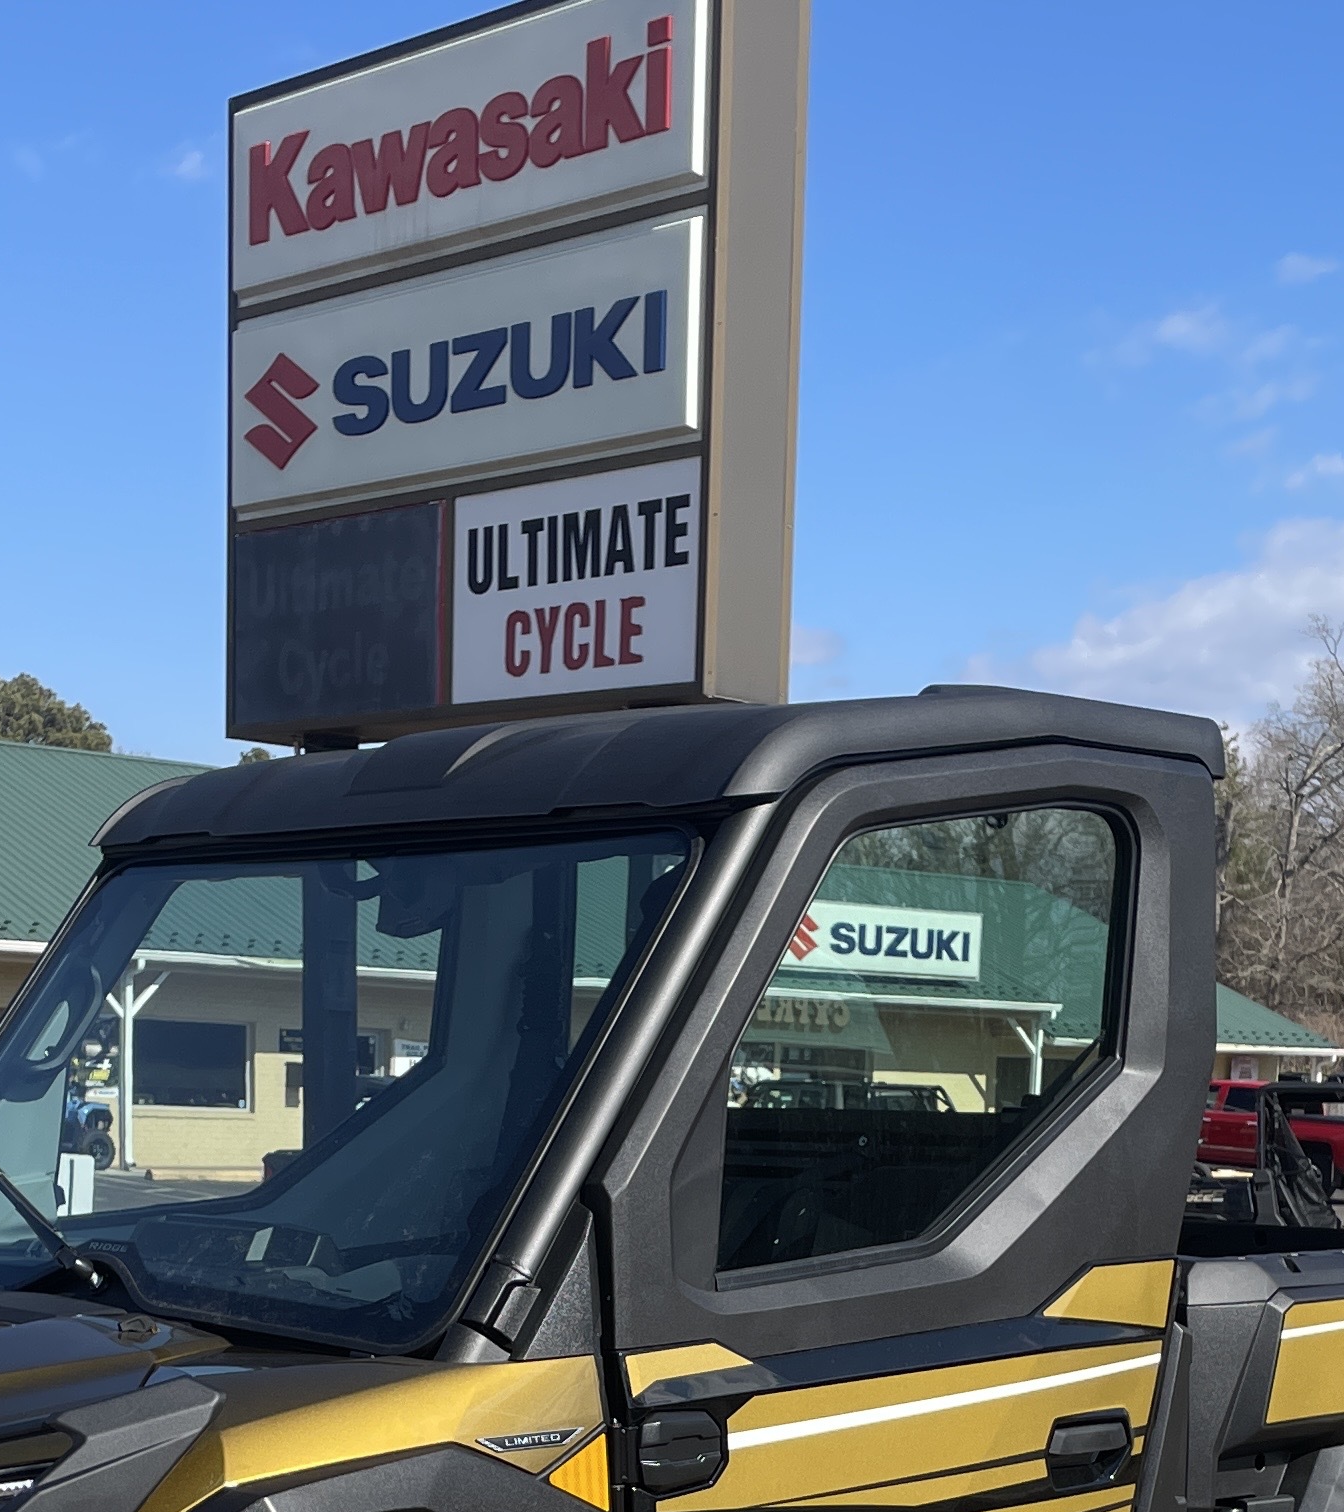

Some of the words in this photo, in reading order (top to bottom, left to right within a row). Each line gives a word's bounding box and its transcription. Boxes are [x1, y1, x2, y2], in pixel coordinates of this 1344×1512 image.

[248, 15, 674, 246] Kawasaki
[331, 289, 668, 437] SUZUKI
[466, 494, 691, 595] ULTIMATE
[504, 596, 645, 678] CYCLE
[830, 922, 971, 963] SUZUKI
[88, 1241, 129, 1254] RIDGE
[504, 1433, 561, 1447] LIMITED
